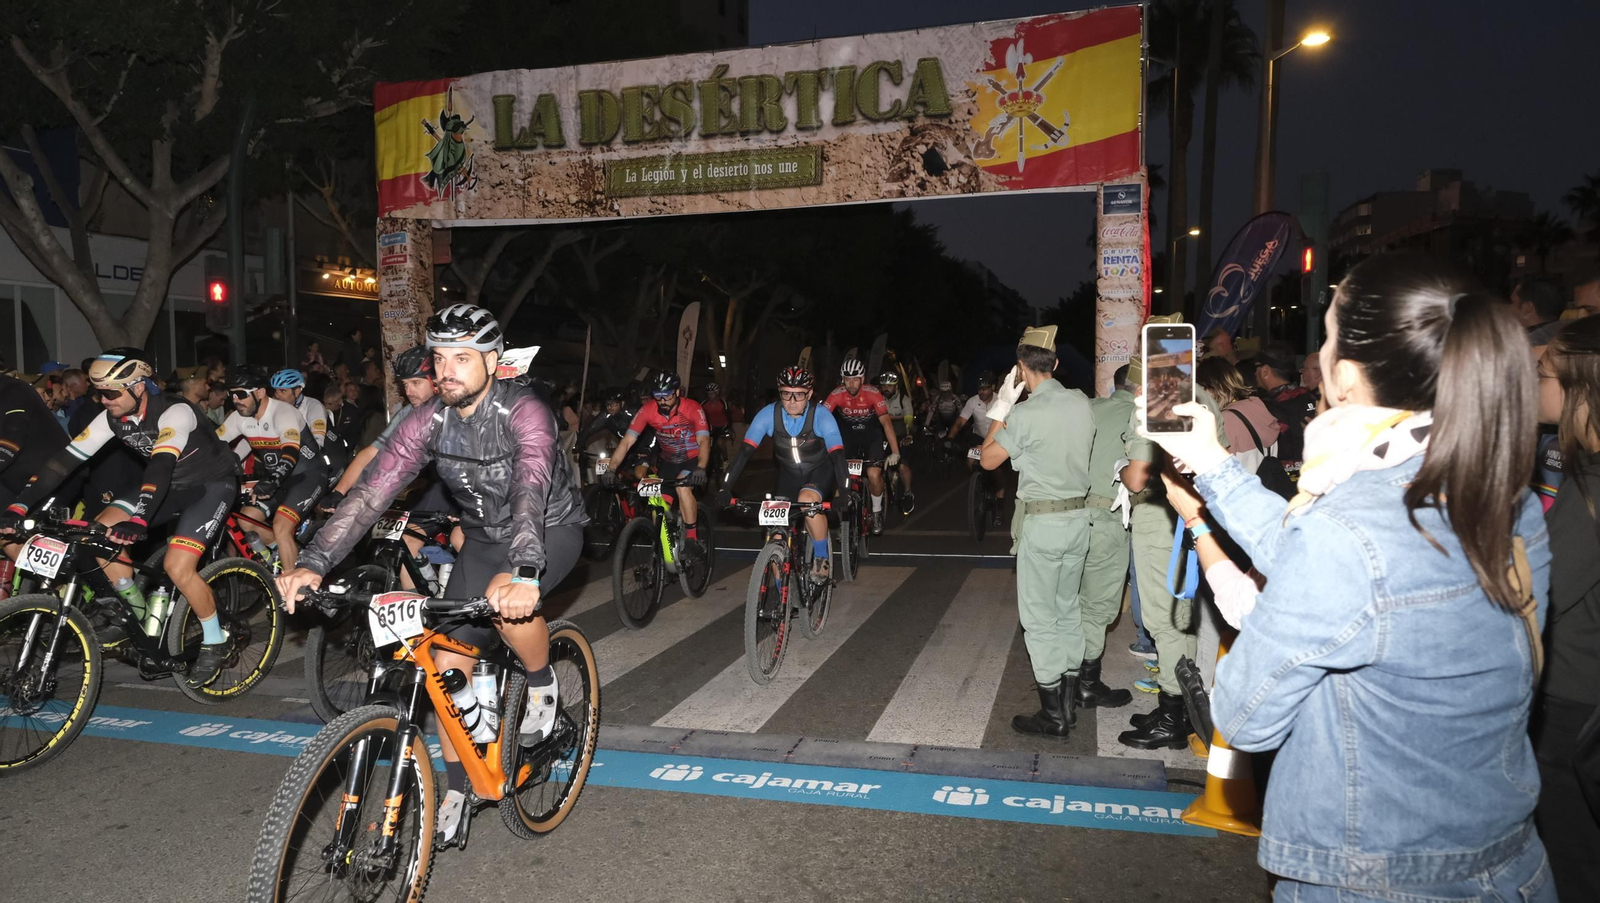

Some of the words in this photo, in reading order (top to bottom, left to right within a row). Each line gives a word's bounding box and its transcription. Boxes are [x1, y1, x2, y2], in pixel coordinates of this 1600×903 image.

[493, 94, 566, 149] LA
[578, 57, 953, 146] DESÉRTICA
[625, 169, 637, 183] La
[641, 166, 675, 184] Legión
[681, 168, 688, 182] y
[693, 165, 702, 179] el
[707, 162, 749, 178] desierto
[754, 164, 773, 175] nos
[778, 161, 798, 174] une
[1103, 255, 1140, 265] RENTA
[1247, 239, 1278, 281] JUEGA
[383, 310, 405, 319] BBVA
[1101, 353, 1139, 363] primafl
[763, 508, 786, 518] 6208
[377, 518, 403, 532] 6220
[27, 544, 60, 567] 7950
[378, 599, 417, 628] 6516
[586, 707, 598, 756] MAXXIS
[712, 771, 882, 794] cajamar
[787, 787, 822, 796] CAJA
[825, 790, 871, 800] RURAL
[1002, 795, 1188, 819] cajamar
[1093, 813, 1134, 822] CAJA
[1138, 816, 1190, 826] RURAL
